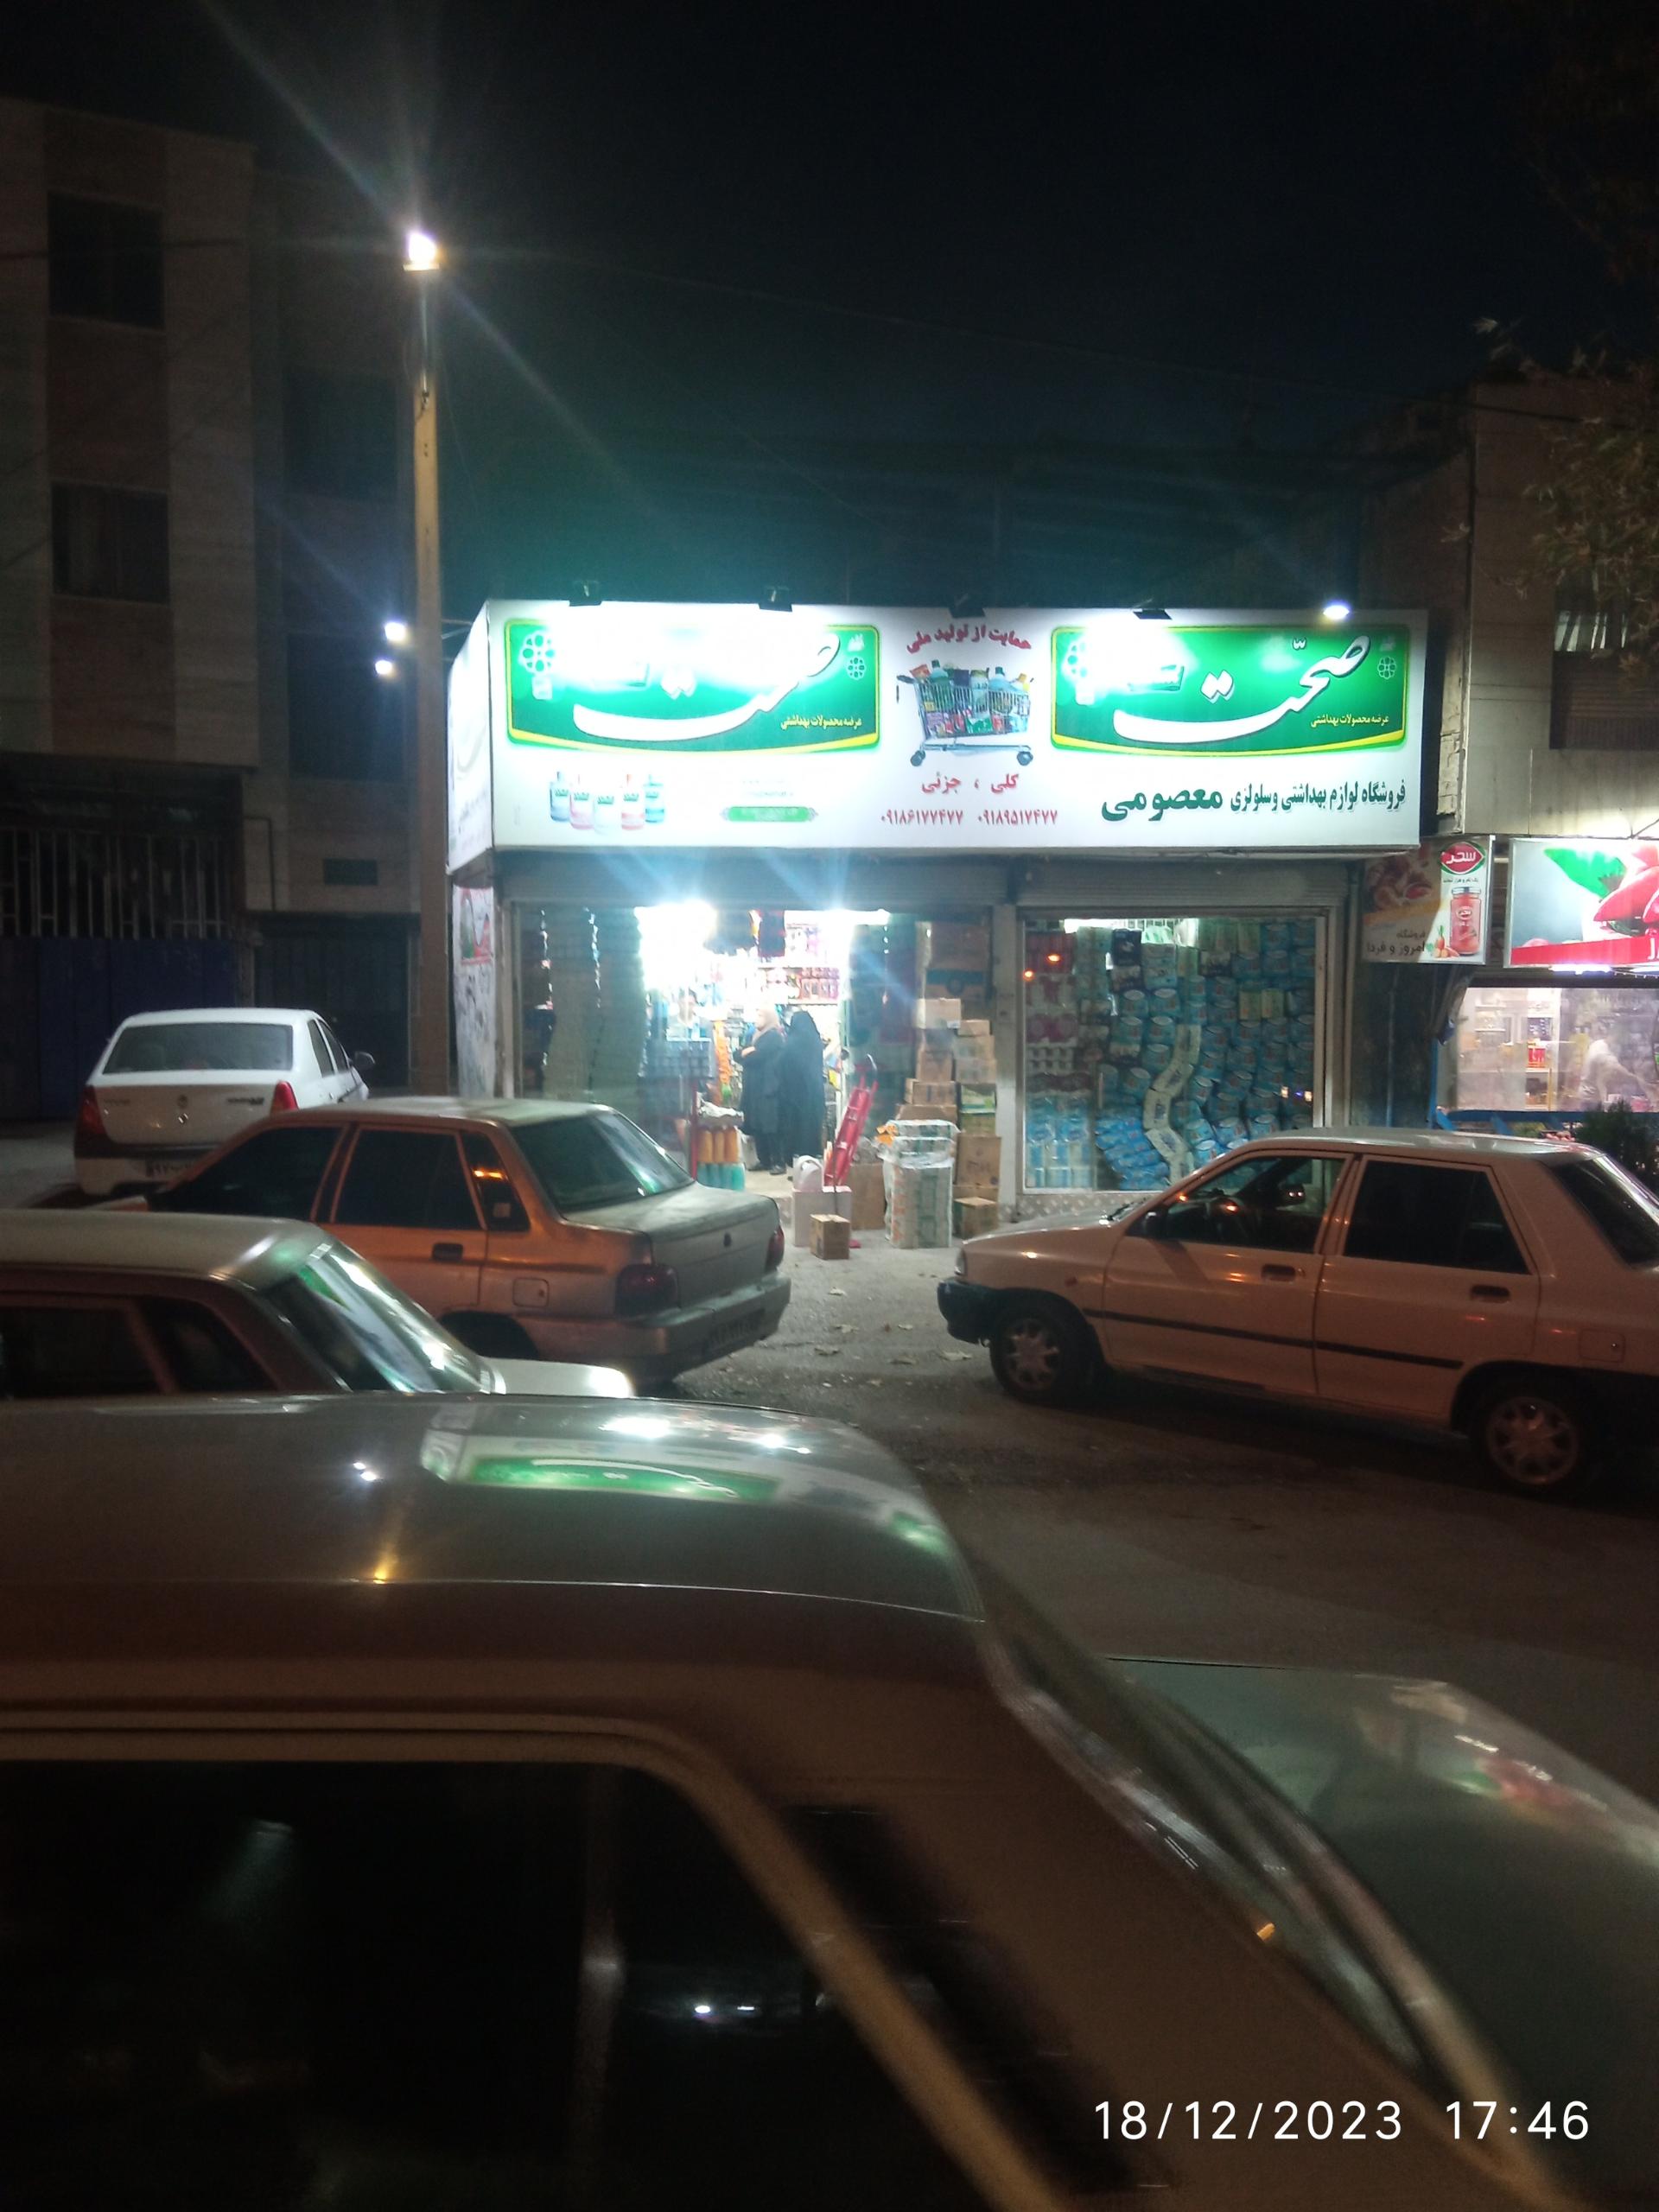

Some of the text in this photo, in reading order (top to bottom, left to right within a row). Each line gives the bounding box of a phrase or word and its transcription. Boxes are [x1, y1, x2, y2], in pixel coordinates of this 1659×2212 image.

[906, 623, 1032, 654] حمایت از تولید ملی
[780, 714, 810, 730] بهداشتی
[1311, 714, 1389, 728] عرضه محصولات بهداشتی
[922, 772, 961, 794] جزئی
[991, 773, 1019, 794] کلی
[1101, 788, 1224, 822] معصومی
[1281, 783, 1326, 810] بهداشتی
[1329, 781, 1359, 811] لوازم
[1361, 779, 1406, 810] فروشگاه
[881, 810, 1058, 824] ۰۹۱۸۹۵۱۷۴۷۷ ۰۹۱۸۶۱۷۷۴۷۷
[1446, 851, 1477, 865] سحر
[1389, 945, 1395, 955] و
[1399, 940, 1425, 956] امروز
